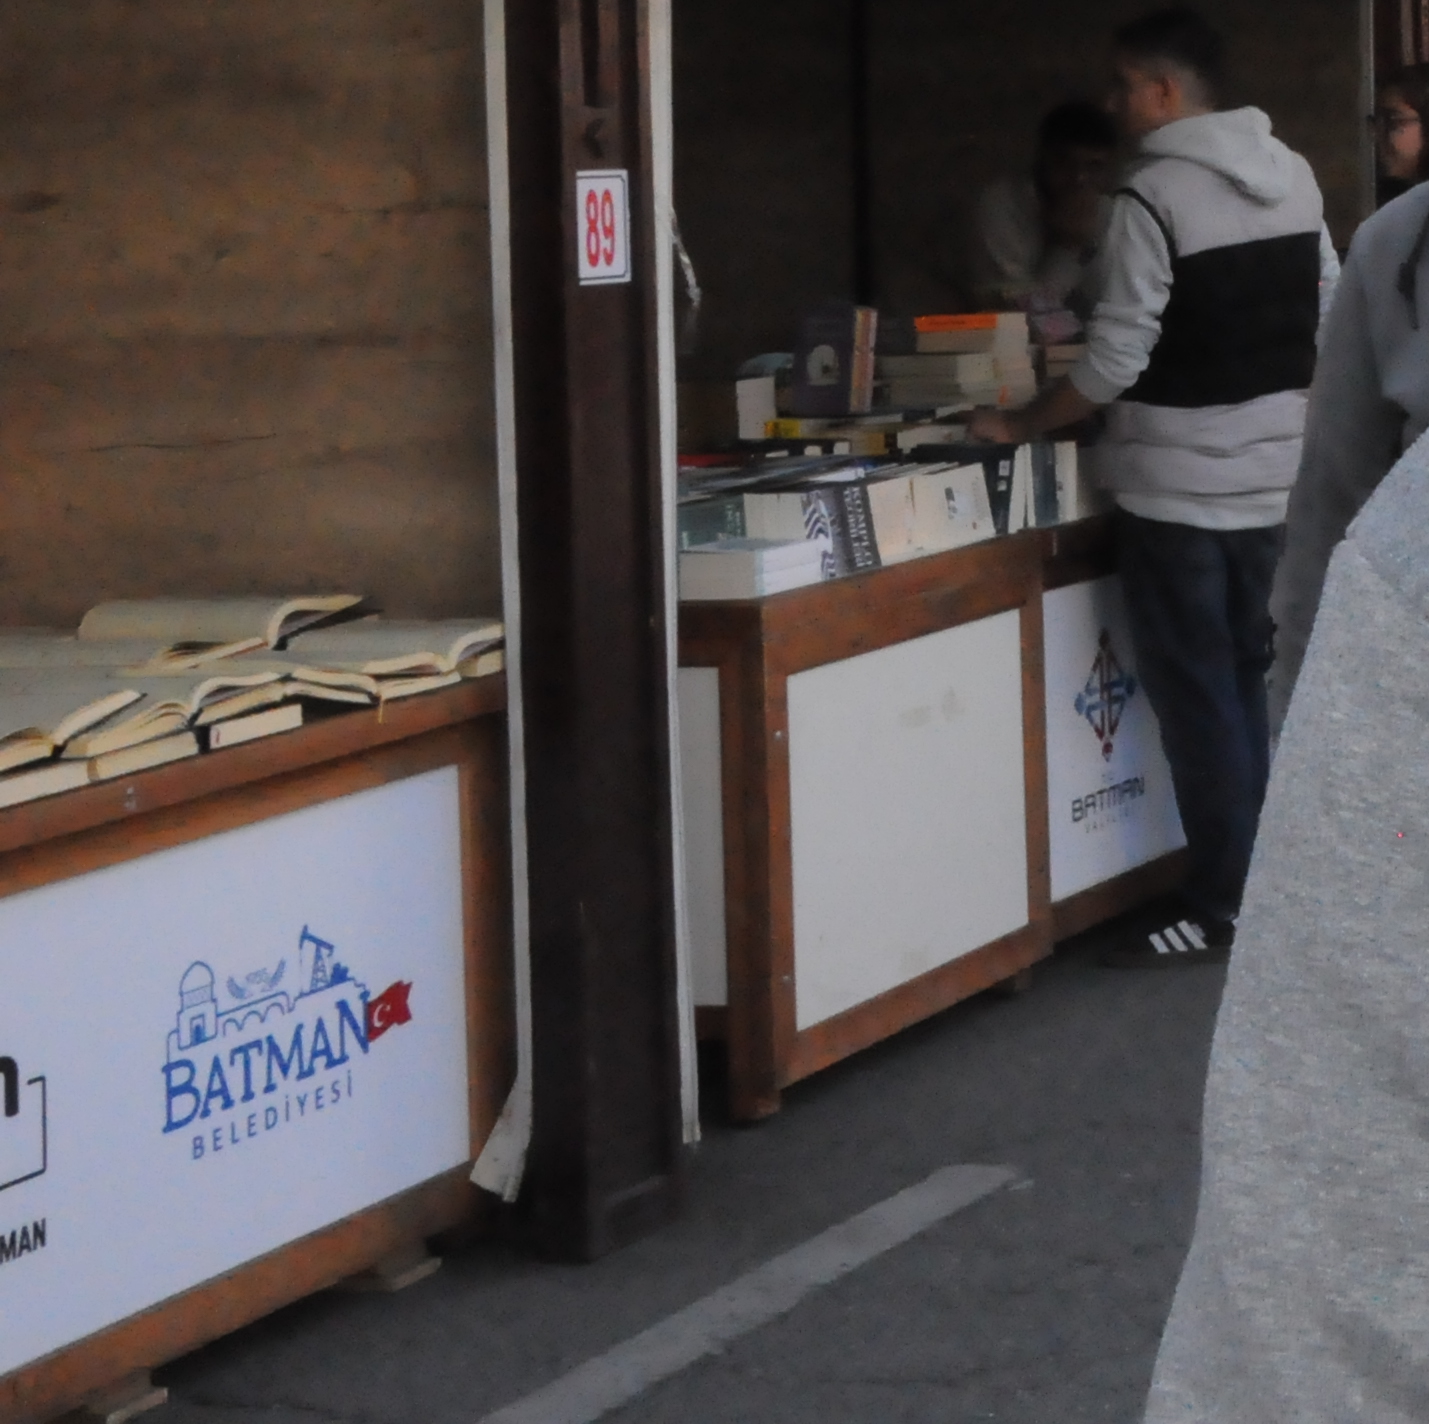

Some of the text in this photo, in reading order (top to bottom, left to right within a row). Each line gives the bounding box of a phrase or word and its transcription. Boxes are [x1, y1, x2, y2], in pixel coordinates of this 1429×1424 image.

[585, 188, 614, 268] 89
[1072, 776, 1145, 822] BATMAN
[162, 996, 369, 1133] BATMAN
[192, 1069, 353, 1160] BELEDİYESİ
